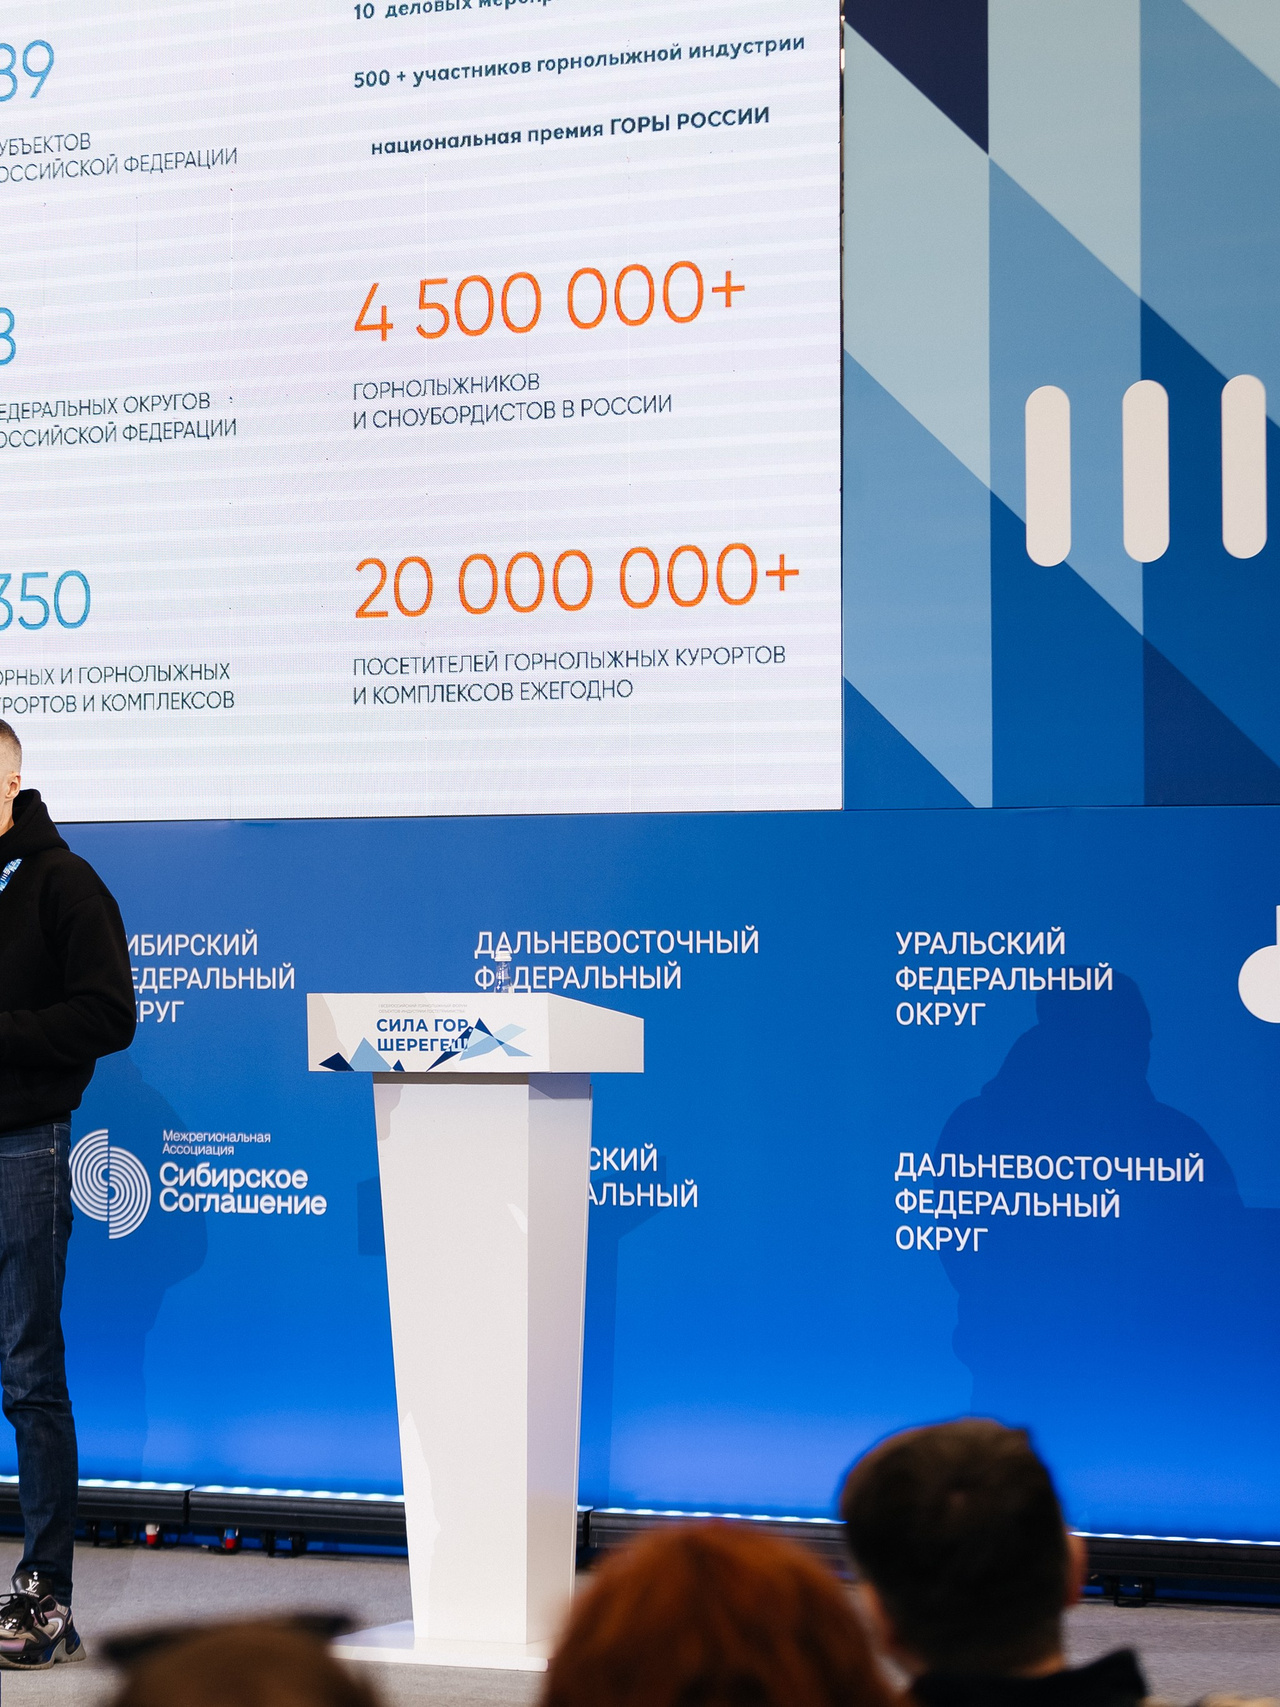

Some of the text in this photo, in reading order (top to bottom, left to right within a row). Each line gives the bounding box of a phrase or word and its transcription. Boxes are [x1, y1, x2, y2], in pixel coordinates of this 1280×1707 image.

[354, 3, 375, 20] 10
[385, 0, 472, 19] деловых
[354, 35, 806, 88] 500 + участников горнолыжной индустрии
[371, 106, 770, 156] национальная премия ГОРЫ РОССИИ
[123, 147, 238, 174] ФЕДЕРАЦИИ
[354, 260, 746, 341] 4 500 000+
[353, 372, 541, 401] ГОРНОЛЫЖНИКОВ
[123, 392, 211, 415] ОКРУГОВ
[353, 393, 672, 430] И СНОУБОРДИСТОВ В РОССИИ
[122, 418, 237, 443] ФЕДЕРАЦИИ
[354, 542, 801, 619] 20 000 000+
[61, 668, 72, 684] И
[79, 663, 231, 684] ГОРНОЛЫЖНЫХ
[353, 645, 786, 676] ПОСЕТИТЕЛЕЙ ГОРНОЛЫЖНЫХ КУРОРТОВ
[83, 695, 95, 712] И
[102, 690, 235, 712] КОМПЛЕКСОВ
[353, 678, 633, 706] И КОМПЛЕКСОВ ЕЖЕГОДНО
[474, 925, 760, 959] ДАЛЬНЕВОСТОЧНЫЙ
[895, 926, 1066, 956] УРАЛЬСКИЙ
[474, 961, 682, 993] ФДЕРАЛЬНЫЙ
[895, 962, 1113, 995] ФЕДЕРАЛЬНЫЙ
[135, 1001, 185, 1023] РУГ
[376, 1018, 429, 1032] СИЛА
[895, 1001, 986, 1027] ОКРУГ
[377, 1038, 468, 1052] ШЕРЕГЕШ
[162, 1129, 271, 1146] Межрегиональная
[162, 1143, 235, 1156] Ассоциация
[159, 1161, 308, 1192] Сибирское
[894, 1152, 1205, 1183] ДАЛЬНЕВОСТОЧНЫЙ
[159, 1187, 328, 1216] Соглашение
[894, 1188, 1120, 1219] ФЕДЕРАЛЬНЫЙ
[895, 1225, 988, 1252] ОКРУГ
